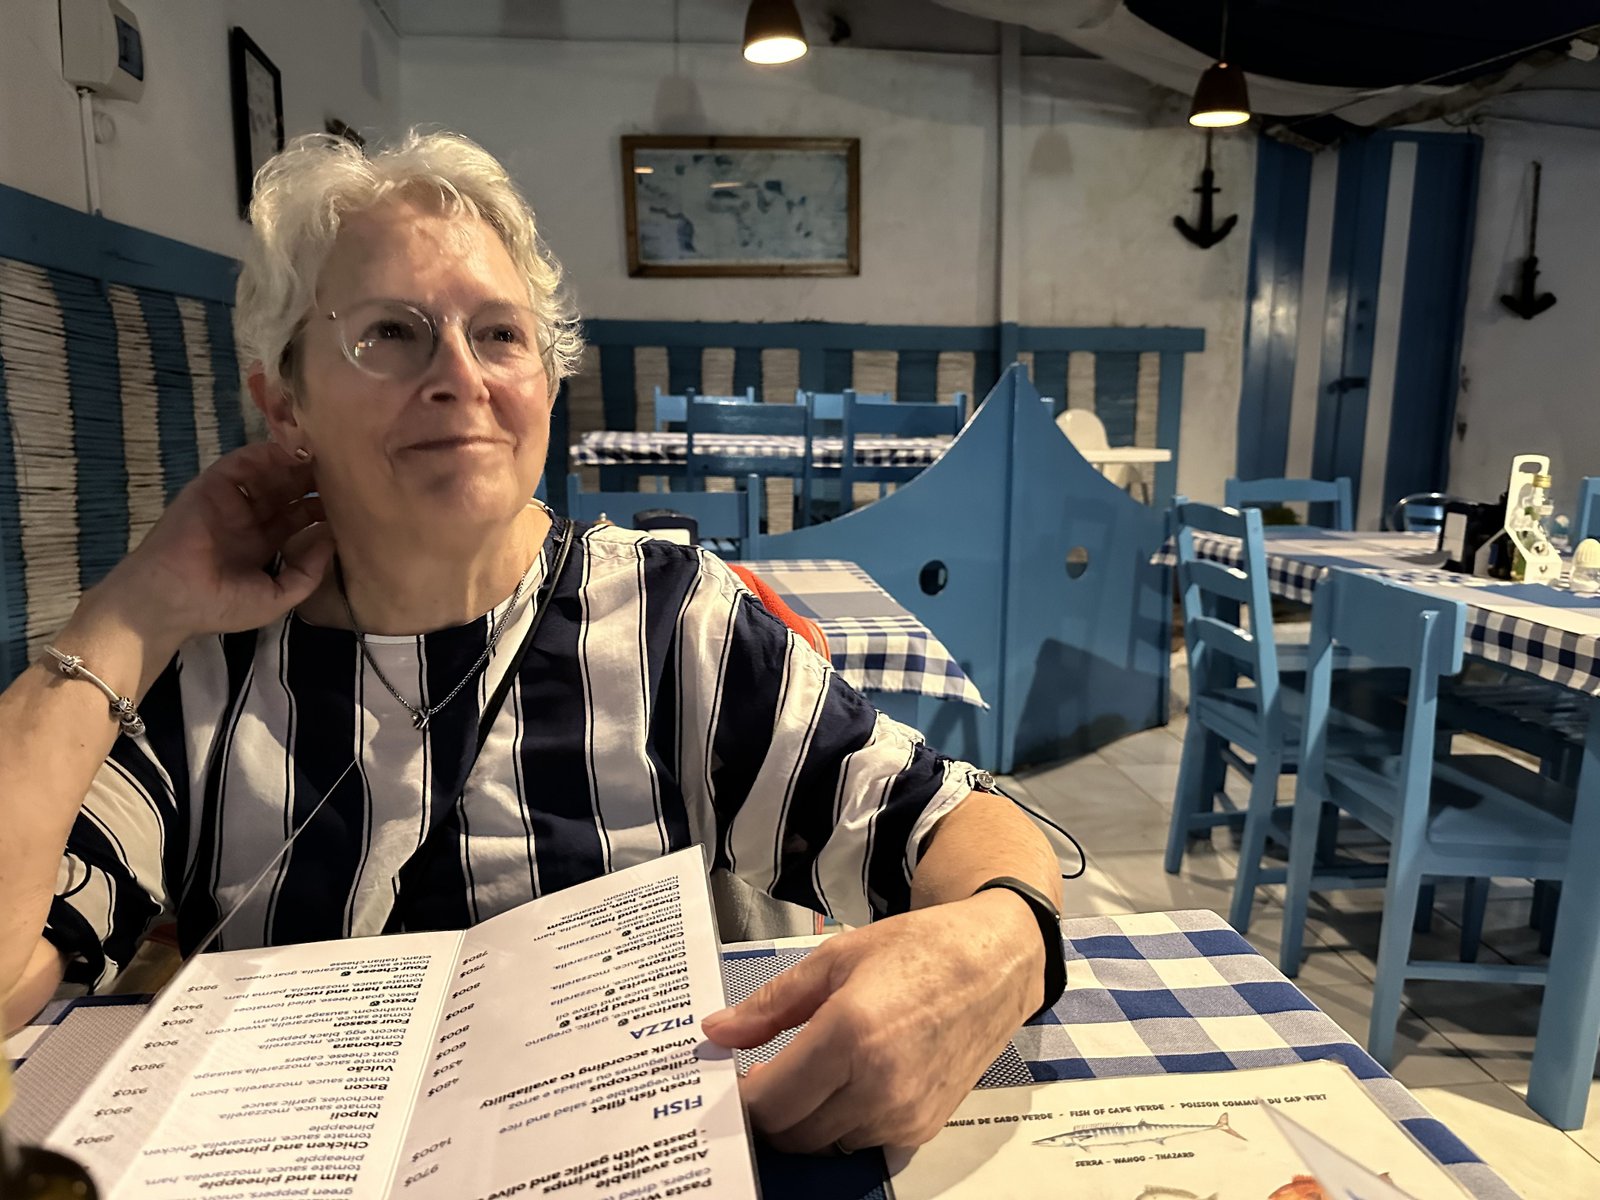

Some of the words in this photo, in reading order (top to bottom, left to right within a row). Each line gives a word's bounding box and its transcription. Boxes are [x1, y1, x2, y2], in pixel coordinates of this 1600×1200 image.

[641, 896, 680, 910] Cheese
[547, 908, 607, 930] mushroom
[590, 916, 615, 928] ham
[618, 908, 638, 920] and
[635, 913, 682, 930] Romana
[616, 932, 684, 956] Capricciosa
[638, 951, 686, 969] Calzone
[619, 966, 688, 991] Margherita
[284, 990, 323, 998] rucola
[652, 983, 690, 996] Garlic
[612, 994, 649, 1010] bread
[632, 1000, 691, 1020] Marinara
[445, 1003, 474, 1020] 800$
[575, 1005, 609, 1020] pizza
[334, 1020, 378, 1028] season
[630, 1014, 694, 1040] PIZZA
[440, 1025, 470, 1043] 800$
[332, 1041, 402, 1049] Carbonara
[436, 1042, 466, 1060] 600$
[651, 1038, 696, 1054] Whelk
[578, 1050, 648, 1074] according
[651, 1056, 699, 1075] Grilled
[560, 1072, 575, 1080] to
[590, 1070, 648, 1092] octopus
[660, 1077, 700, 1092] Fresh
[480, 1078, 558, 1109] availability
[630, 1089, 656, 1102] fish
[592, 1098, 626, 1114] fillet
[654, 1095, 702, 1119] FISH
[978, 1117, 990, 1125] DE
[994, 1115, 1020, 1124] CABO
[1022, 1112, 1053, 1122] VERDE
[1070, 1110, 1090, 1118] FISH
[1093, 1108, 1106, 1116] OF
[1108, 1106, 1132, 1114] CAPE
[1134, 1104, 1164, 1112] VERDE
[1180, 1101, 1220, 1109] POISSON
[1222, 1098, 1263, 1107] COMMU
[1304, 1094, 1328, 1102] VERT
[329, 1110, 379, 1120] Napoli
[306, 1141, 368, 1150] Chicken
[654, 1129, 696, 1148] pasta
[190, 1144, 270, 1160] pineapple
[272, 1143, 303, 1152] and
[613, 1145, 650, 1161] with
[654, 1140, 698, 1158] pasta
[613, 1156, 650, 1172] with
[674, 1149, 708, 1164] Also
[1075, 1159, 1104, 1168] SERRA
[1113, 1156, 1146, 1164] WAHOO
[1156, 1152, 1195, 1160] THAZARD
[564, 1155, 610, 1176] garlic
[198, 1174, 282, 1190] pineapple
[284, 1174, 316, 1184] and
[320, 1174, 358, 1182] Ham
[530, 1172, 560, 1189] and
[543, 1168, 609, 1194] shrimps
[596, 1161, 669, 1188] available
